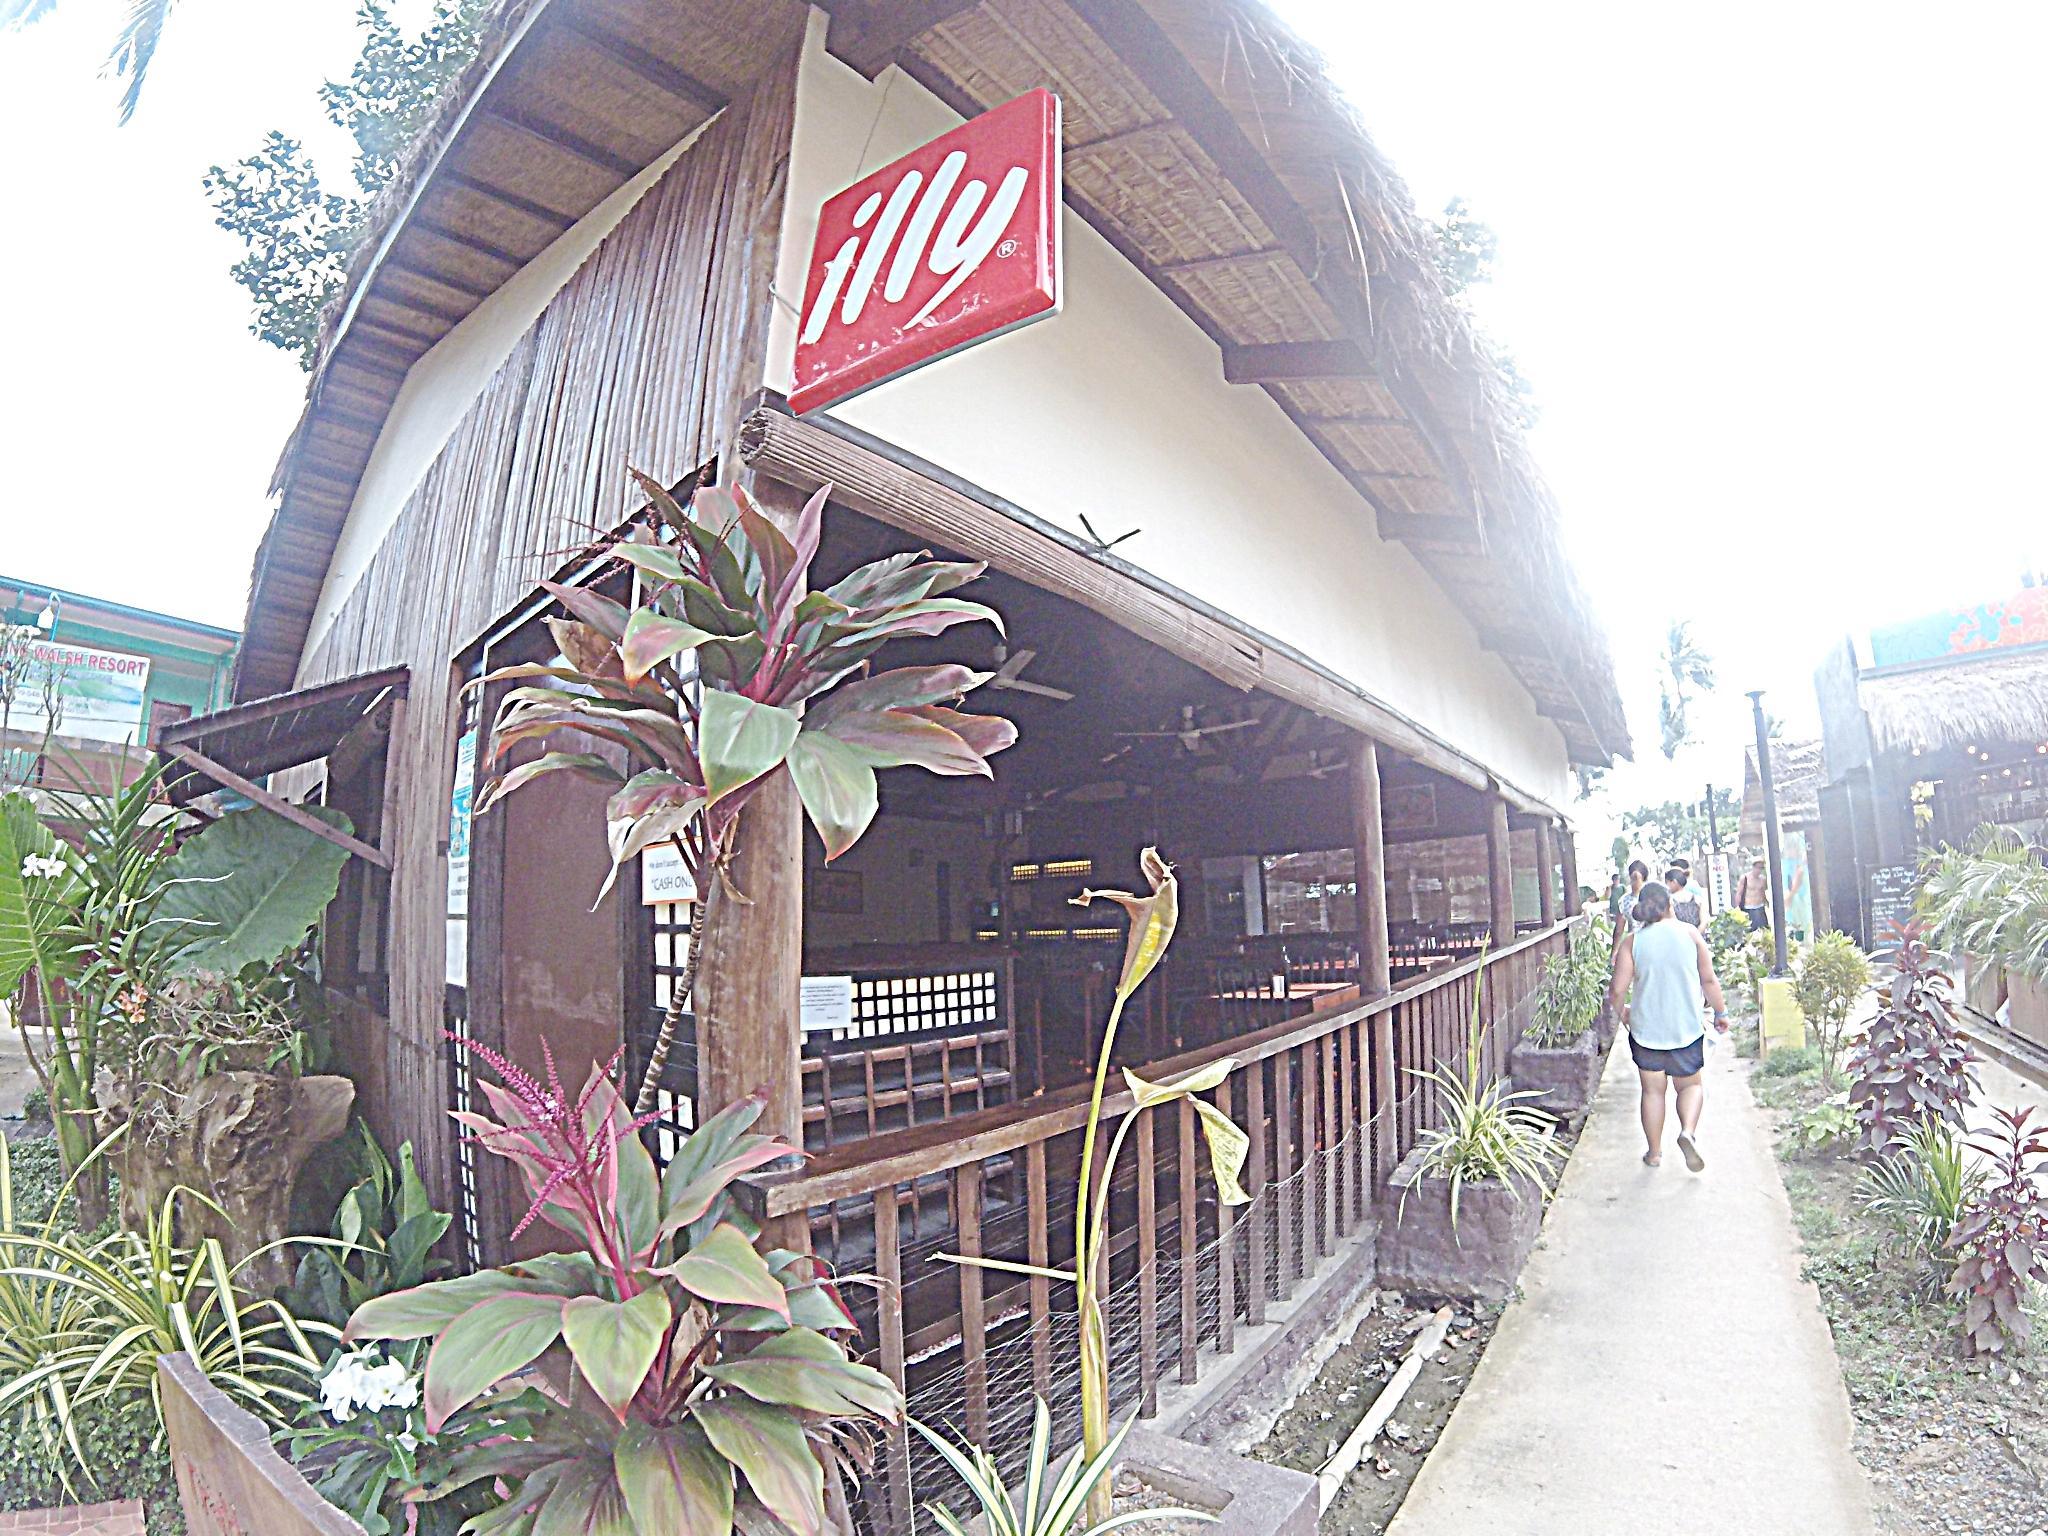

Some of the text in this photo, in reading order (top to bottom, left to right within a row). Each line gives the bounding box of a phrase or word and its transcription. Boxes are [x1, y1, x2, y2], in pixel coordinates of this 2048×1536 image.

[800, 150, 1029, 345] illy
[35, 645, 84, 666] WALSH
[88, 654, 147, 676] RESORT
[674, 875, 692, 888] ONL
